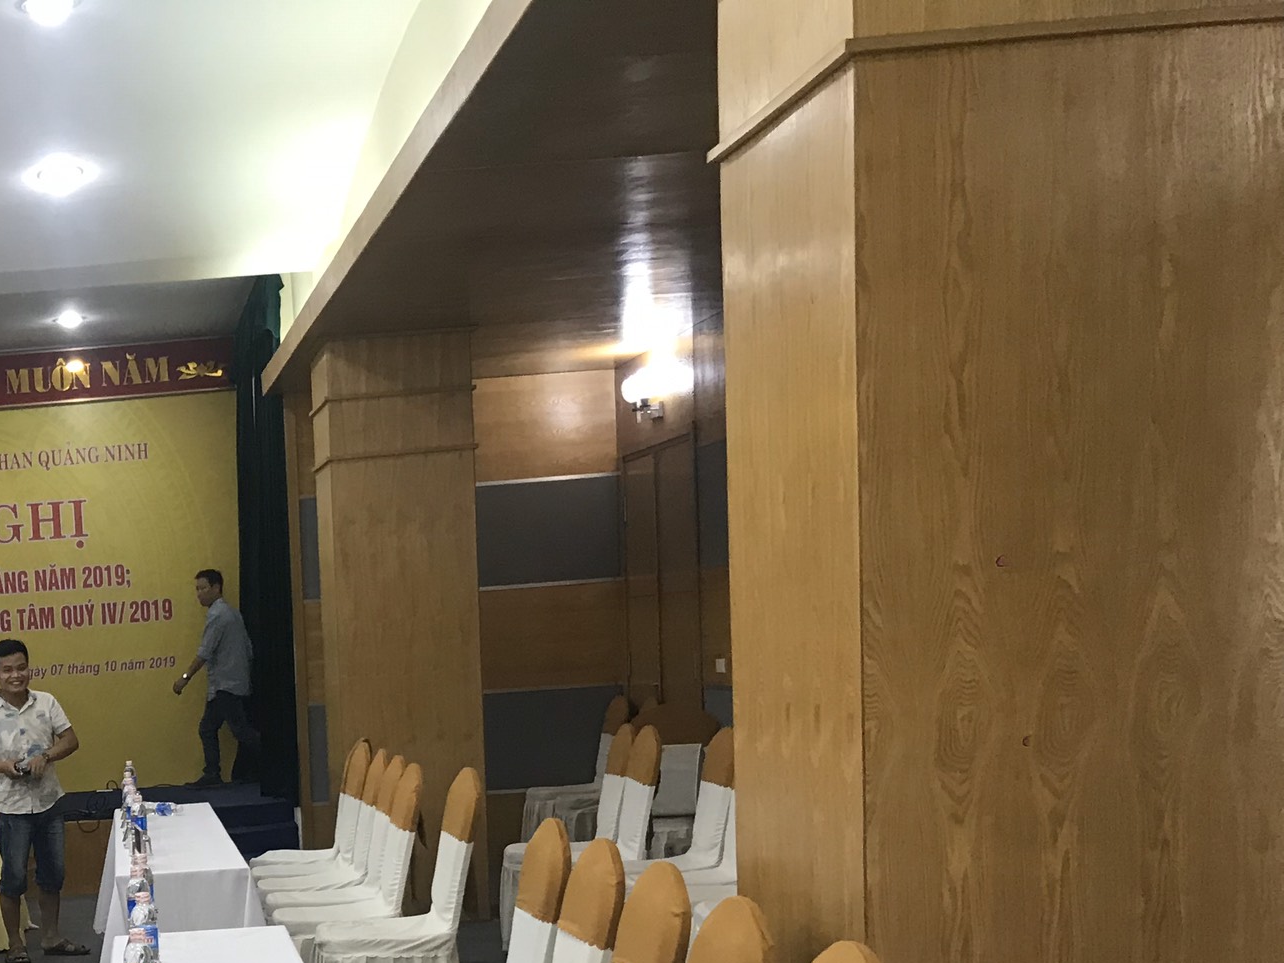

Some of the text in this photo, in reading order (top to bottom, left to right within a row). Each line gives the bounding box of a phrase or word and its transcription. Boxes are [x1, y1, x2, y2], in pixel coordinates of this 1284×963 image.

[5, 358, 91, 395] MUÔN
[100, 352, 170, 388] NĂM
[37, 442, 100, 471] QUẢNG
[103, 442, 149, 463] NINH
[33, 563, 77, 593] NĂM
[81, 563, 132, 589] 2019;
[16, 603, 56, 631] TÂM
[60, 598, 95, 631] QUÝ
[29, 665, 47, 680] gày
[50, 663, 64, 676] 07
[67, 661, 100, 677] tháng
[105, 660, 116, 672] 10
[120, 658, 145, 671] năm
[149, 655, 176, 668] 2019
